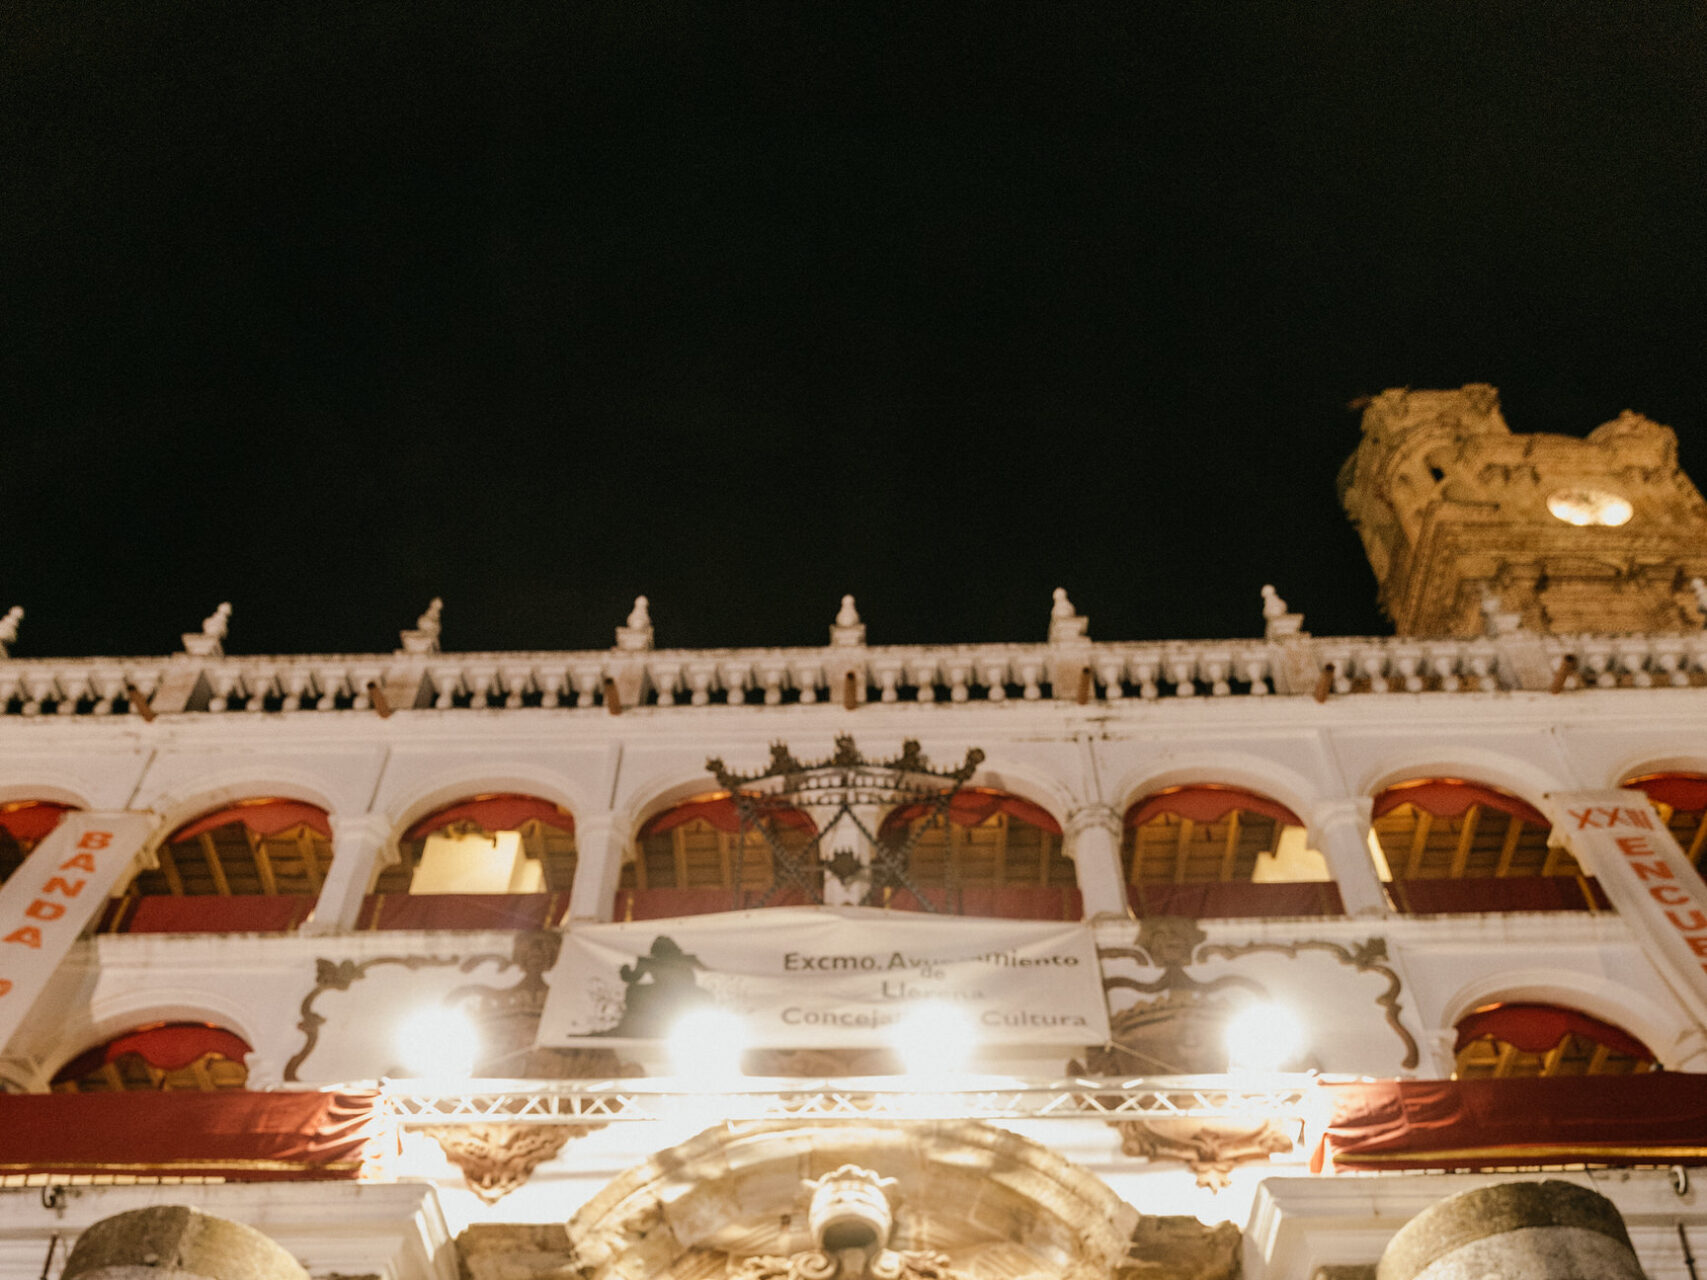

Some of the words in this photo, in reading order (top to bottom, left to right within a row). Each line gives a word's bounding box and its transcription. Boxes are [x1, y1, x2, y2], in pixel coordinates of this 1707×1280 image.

[2, 831, 114, 949] BANDA
[1615, 836, 1707, 974] ENCUE
[783, 952, 882, 972] Excmo.
[887, 949, 1080, 971] Aymiento
[920, 964, 946, 980] de
[781, 1006, 904, 1029] Conceja
[980, 1010, 1088, 1027] Cultura
